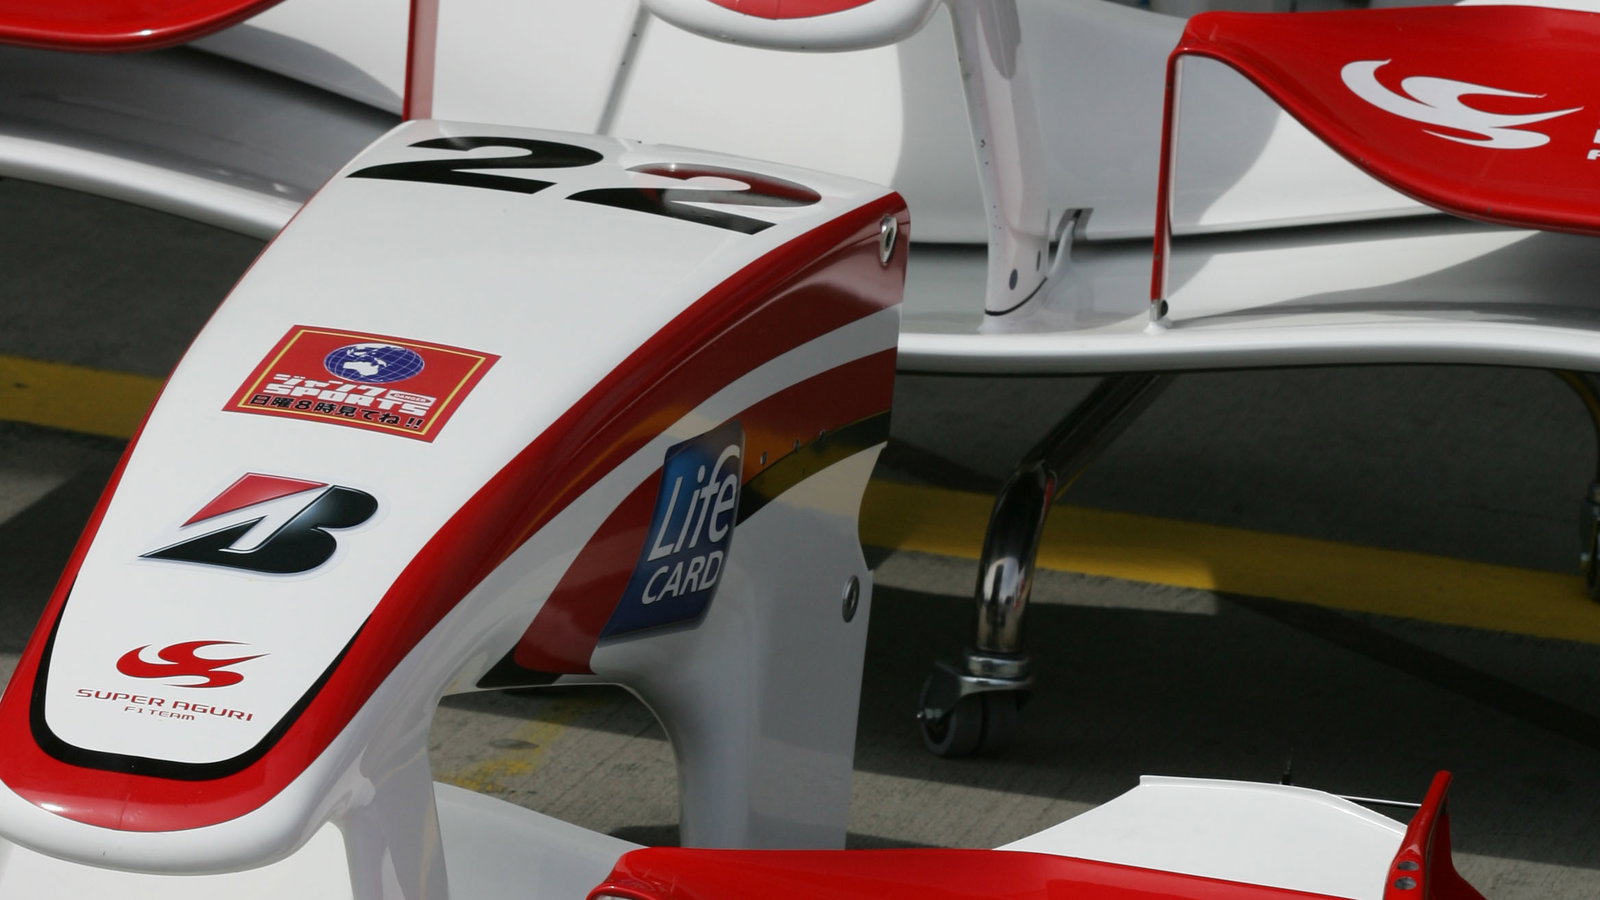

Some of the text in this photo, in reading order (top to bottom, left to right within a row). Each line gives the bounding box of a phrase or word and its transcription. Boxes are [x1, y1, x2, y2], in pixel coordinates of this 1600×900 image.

[344, 136, 822, 235] 22
[263, 383, 429, 416] SPORTS
[273, 373, 387, 398] ジャンク
[647, 444, 740, 562] Life
[641, 550, 724, 605] CARD
[75, 688, 253, 722] SUPER AGURI
[148, 709, 195, 721] TEAM
